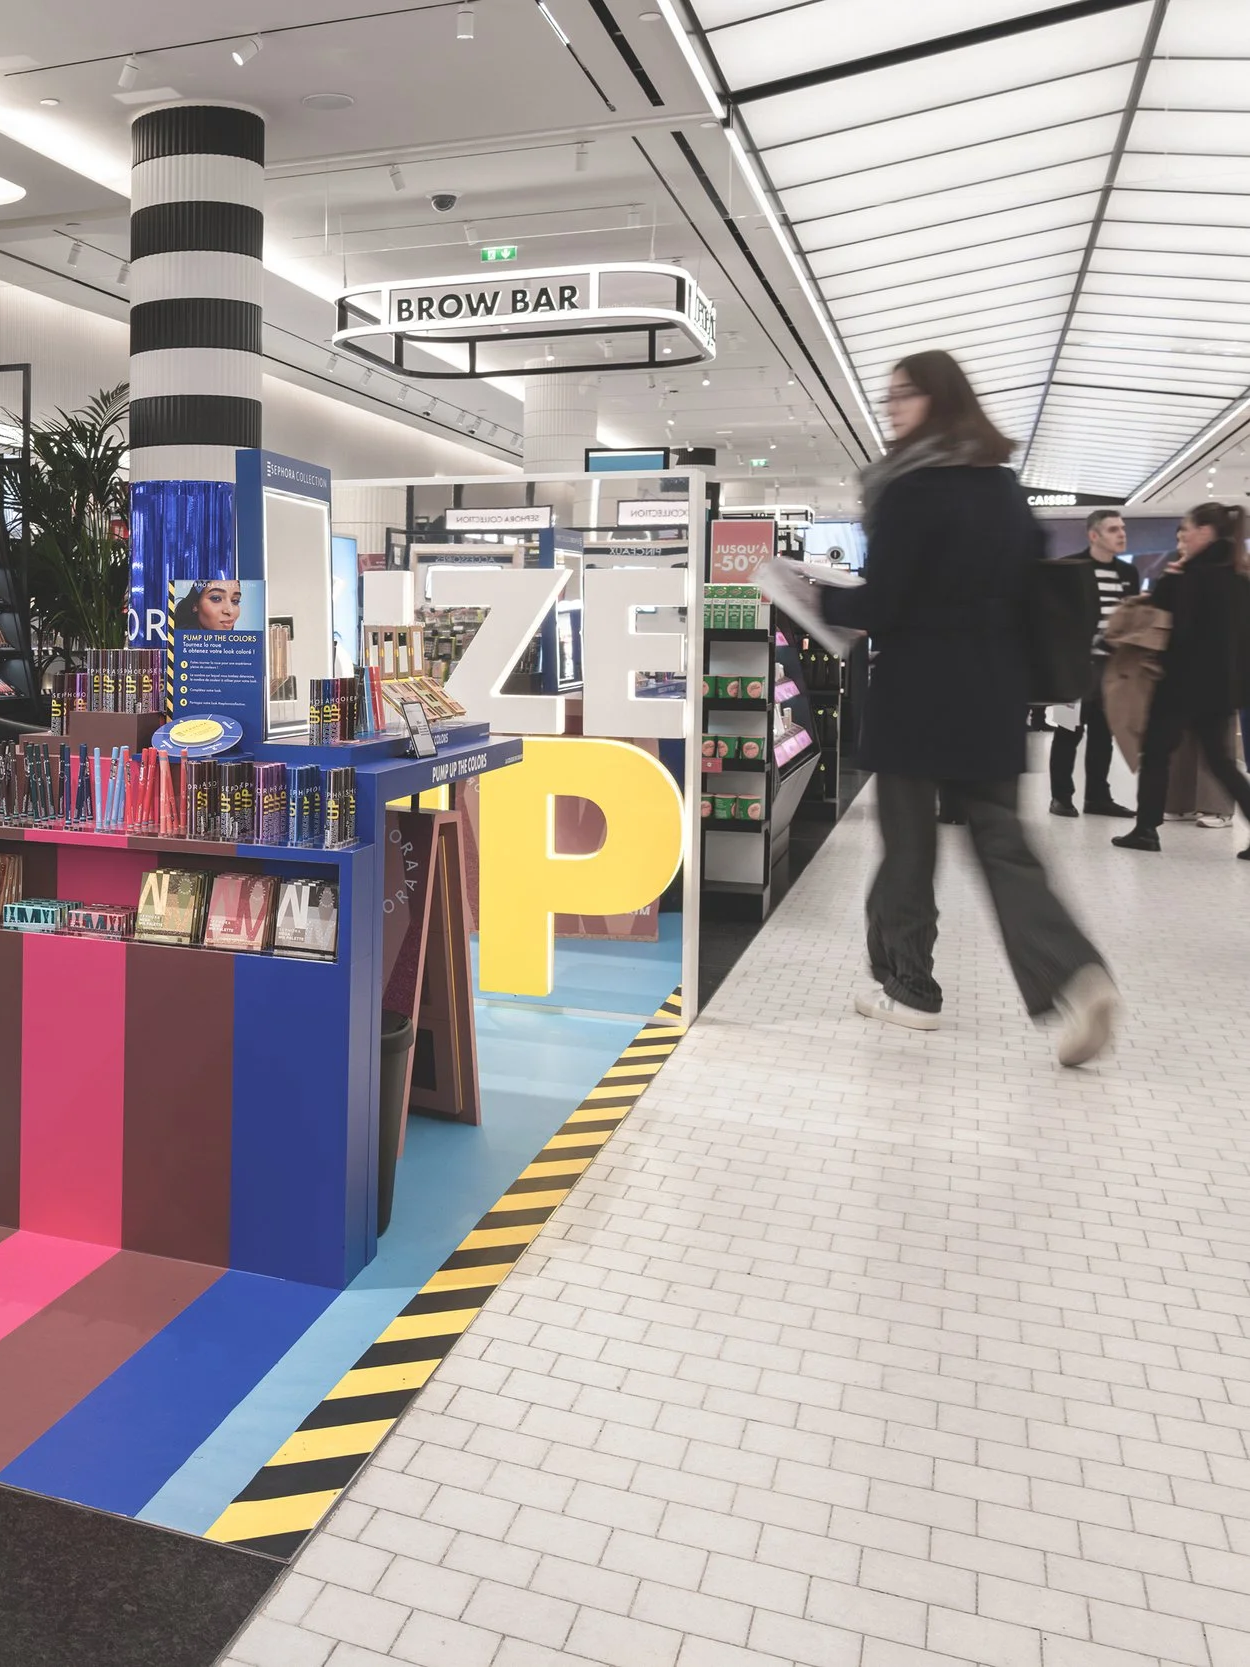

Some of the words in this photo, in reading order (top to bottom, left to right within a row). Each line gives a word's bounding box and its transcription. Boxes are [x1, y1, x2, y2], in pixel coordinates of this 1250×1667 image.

[397, 291, 502, 322] BROW
[511, 284, 580, 314] BAR
[269, 463, 296, 480] SEPHORA
[295, 471, 327, 488] COLLECTION
[1027, 494, 1077, 506] CAISSES
[183, 634, 203, 642] PUMP
[204, 634, 213, 642] UP
[228, 635, 257, 643] COLORS
[126, 675, 137, 694] UP
[143, 674, 153, 693] UP
[52, 699, 62, 717] UP
[309, 705, 321, 724] UP
[432, 763, 449, 783] PUMP
[450, 760, 457, 778] UP
[458, 757, 468, 776] THE
[468, 753, 488, 772] COLORS
[220, 793, 231, 813] UP
[241, 788, 252, 808] UP
[327, 799, 339, 820] UP
